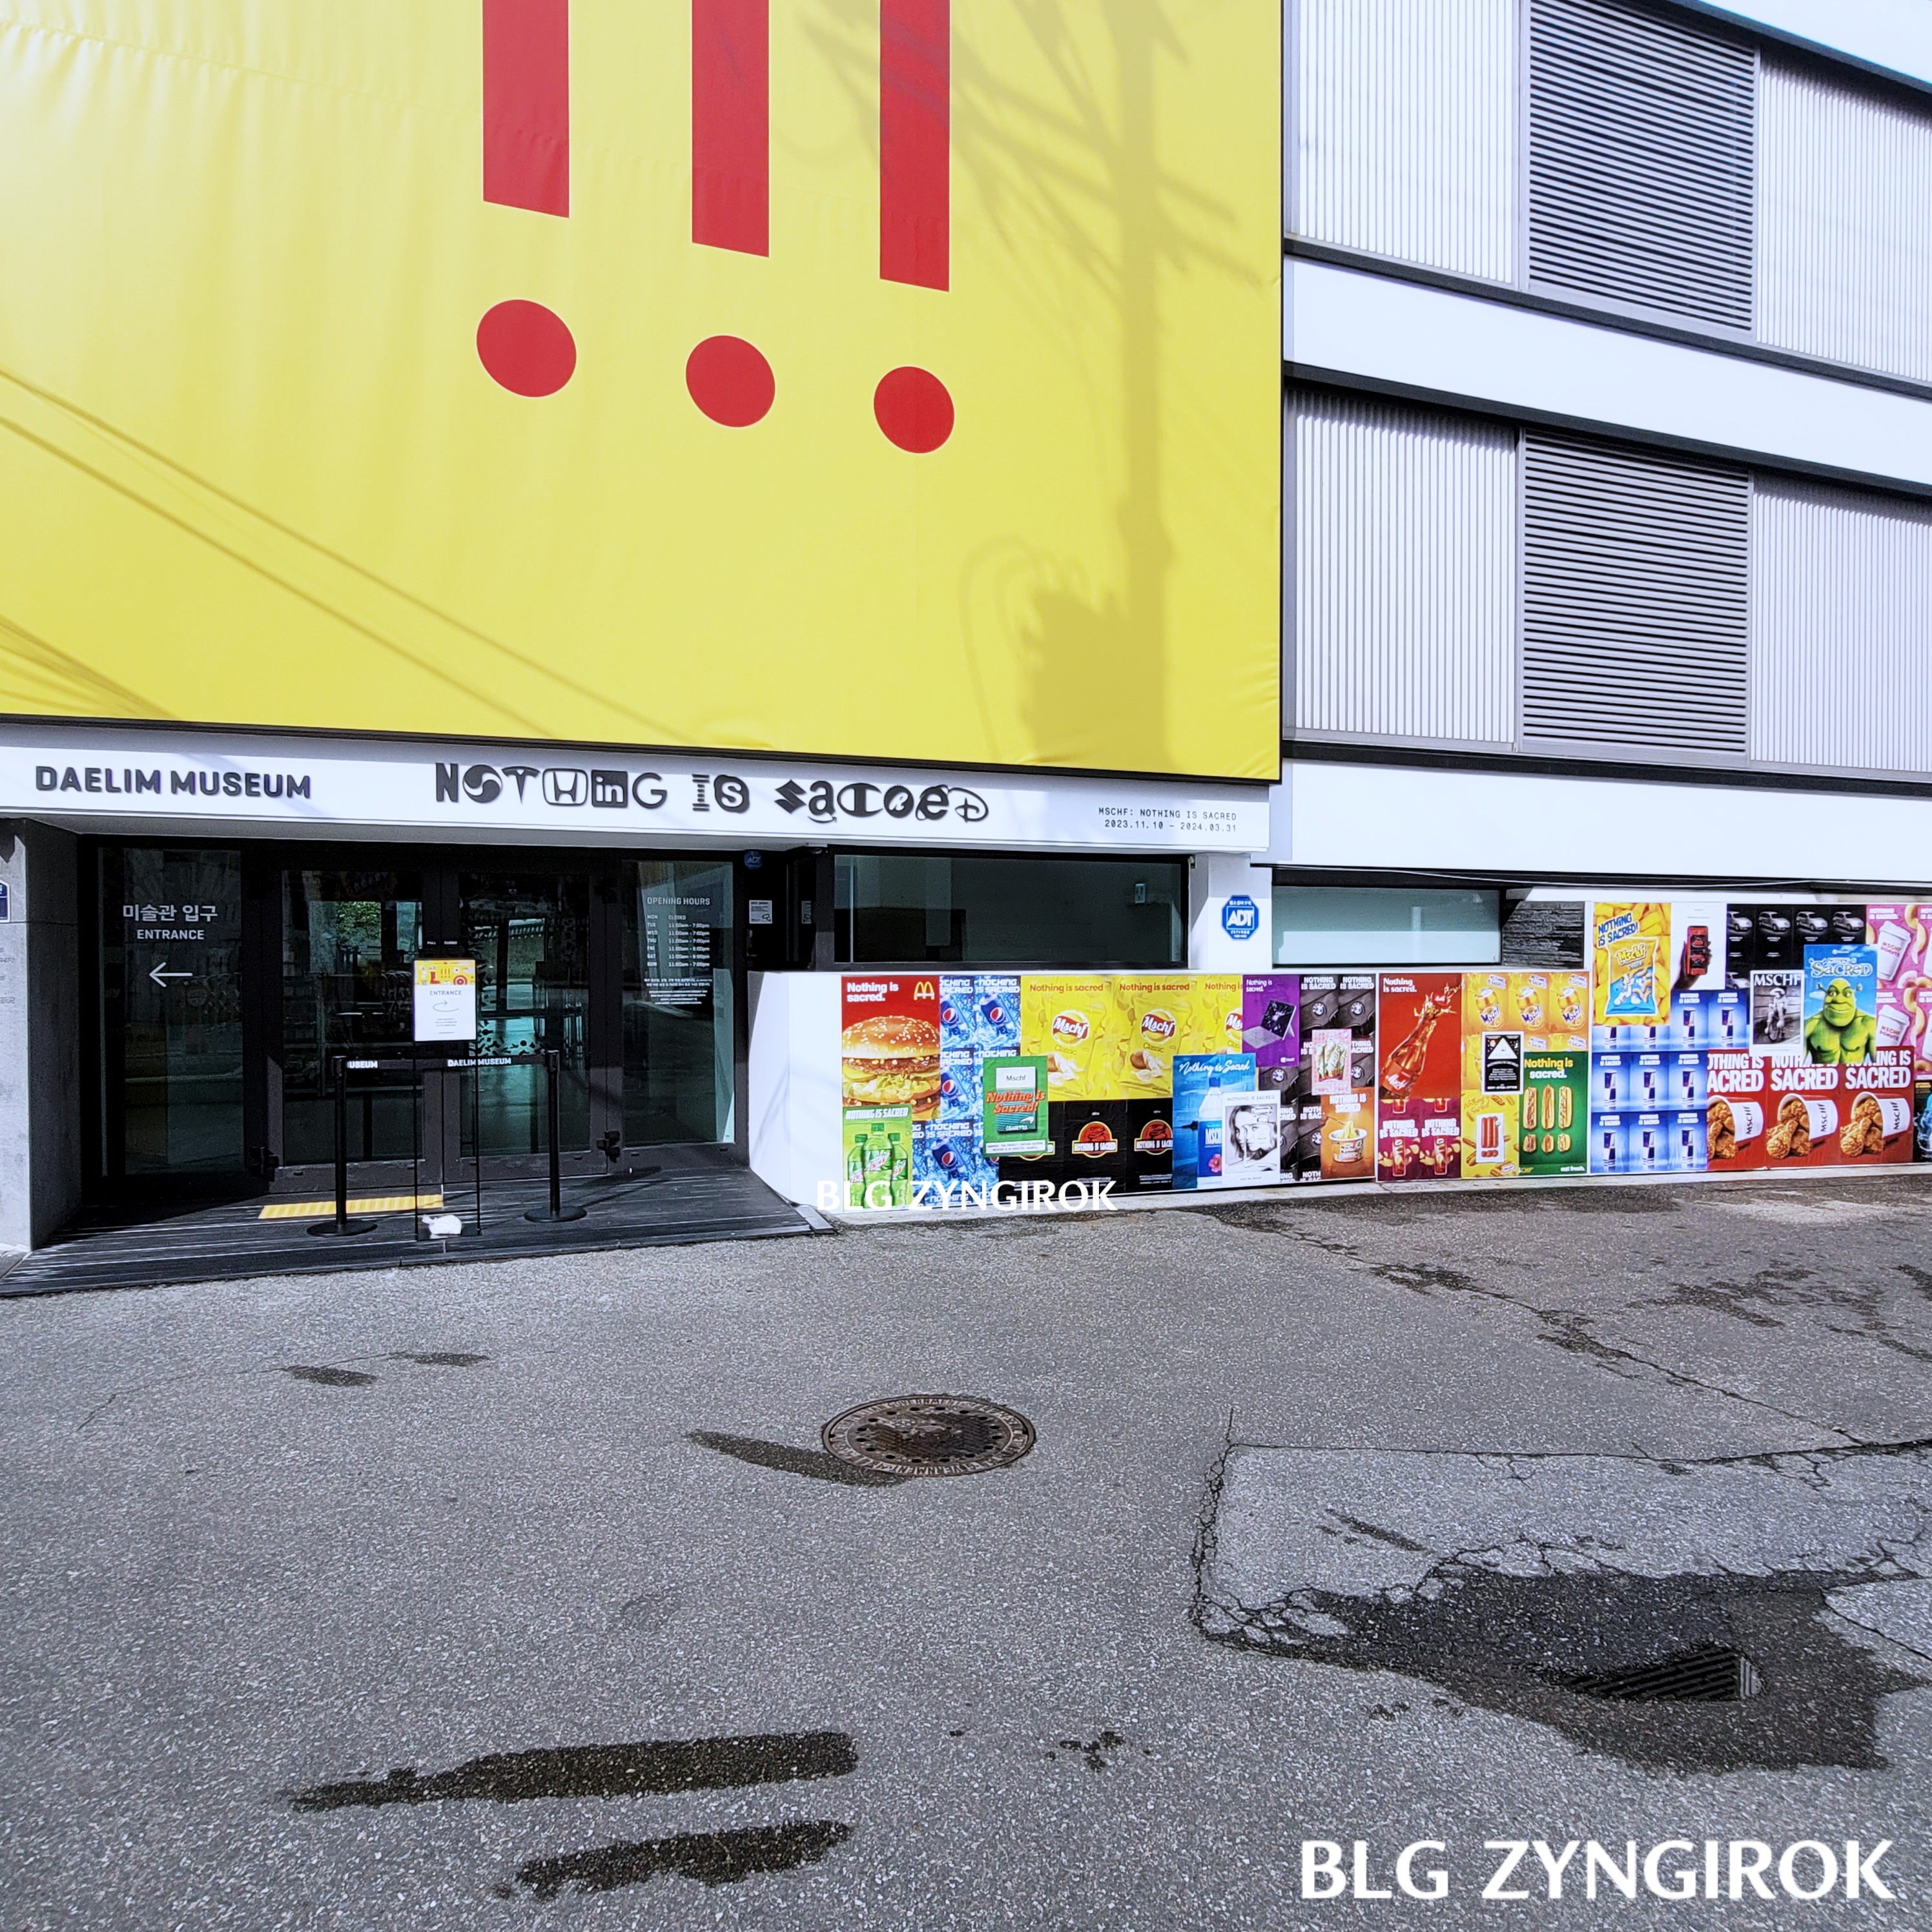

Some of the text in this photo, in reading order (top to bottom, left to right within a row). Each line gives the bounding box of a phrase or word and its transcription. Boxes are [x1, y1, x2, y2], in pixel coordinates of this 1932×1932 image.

[35, 765, 311, 799] DAELIM MUSEUM
[1098, 807, 1237, 821] MSCHF: NOTHING IS SACRED
[1104, 819, 1237, 833] 2023.11.10 2024.03.31
[122, 904, 218, 923] 미술관 입구
[1227, 909, 1255, 927] ADT
[136, 929, 205, 941] ENTRANCE
[847, 981, 899, 994] Nothing is
[1119, 982, 1190, 992] Nothing is sacred
[1205, 982, 1237, 992] Nothing
[1246, 979, 1267, 987] Nothing
[1382, 977, 1413, 987] Nothing
[1754, 974, 1801, 987] MSCHF
[985, 985, 1020, 994] SACRED
[1029, 983, 1064, 993] Nothing
[1065, 983, 1073, 991] is
[847, 992, 886, 1002] sacred.
[1053, 1016, 1089, 1039] Mschf
[1141, 1015, 1176, 1037] Mschf
[447, 1057, 511, 1067] DAELIM MUSEUM
[1524, 1058, 1564, 1070] Nothing
[1565, 1057, 1574, 1067] is
[1899, 1050, 1911, 1066] IS
[1178, 1061, 1214, 1077] Nothing
[1529, 1069, 1568, 1079] sacred.
[1707, 1069, 1765, 1093] ACRED
[1770, 1067, 1839, 1091] SACRED
[1845, 1067, 1911, 1090] SACRED
[986, 1089, 1045, 1104] Nothing is
[993, 1102, 1039, 1114] Sacred!
[1742, 1105, 1753, 1135] MSCHF
[1816, 1103, 1827, 1133] MSCHF
[1889, 1100, 1900, 1131] MSCHF
[936, 1130, 972, 1138] SACRED
